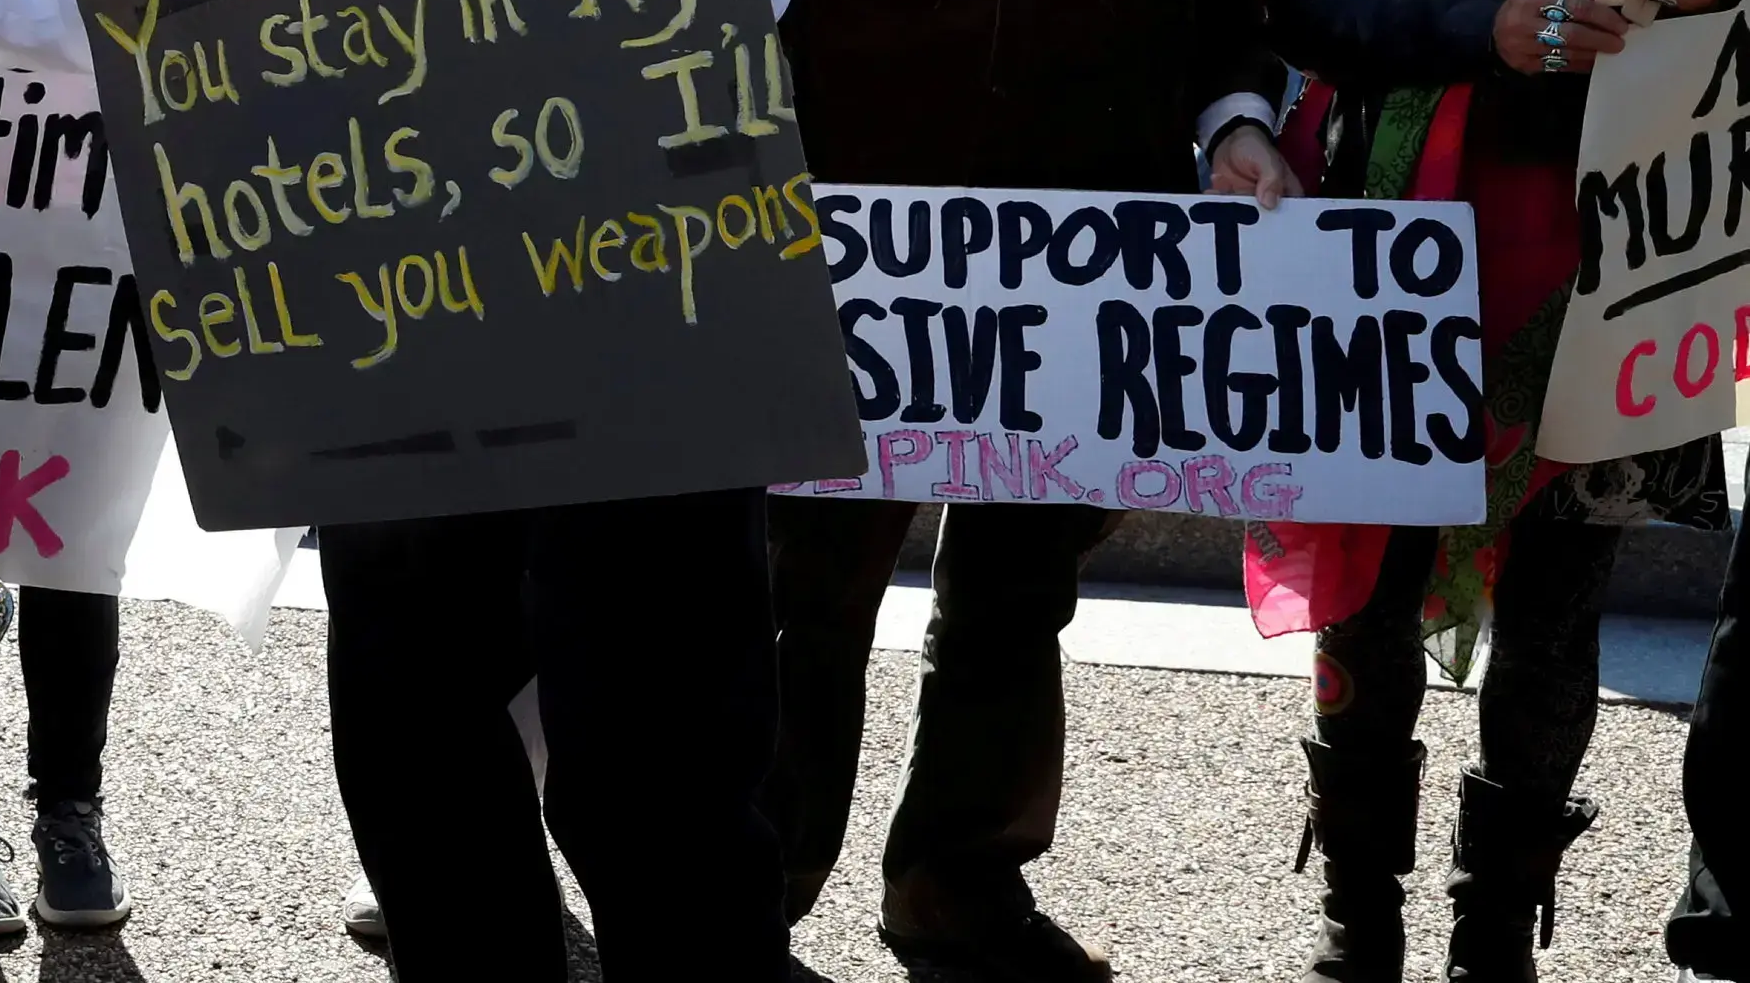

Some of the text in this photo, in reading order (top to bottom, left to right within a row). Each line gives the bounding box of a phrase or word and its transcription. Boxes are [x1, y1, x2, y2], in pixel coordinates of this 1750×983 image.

[334, 245, 485, 370] you
[521, 172, 823, 327] weapons
[818, 195, 1465, 300] SUPPORT TO
[1096, 299, 1488, 466] REGIMES
